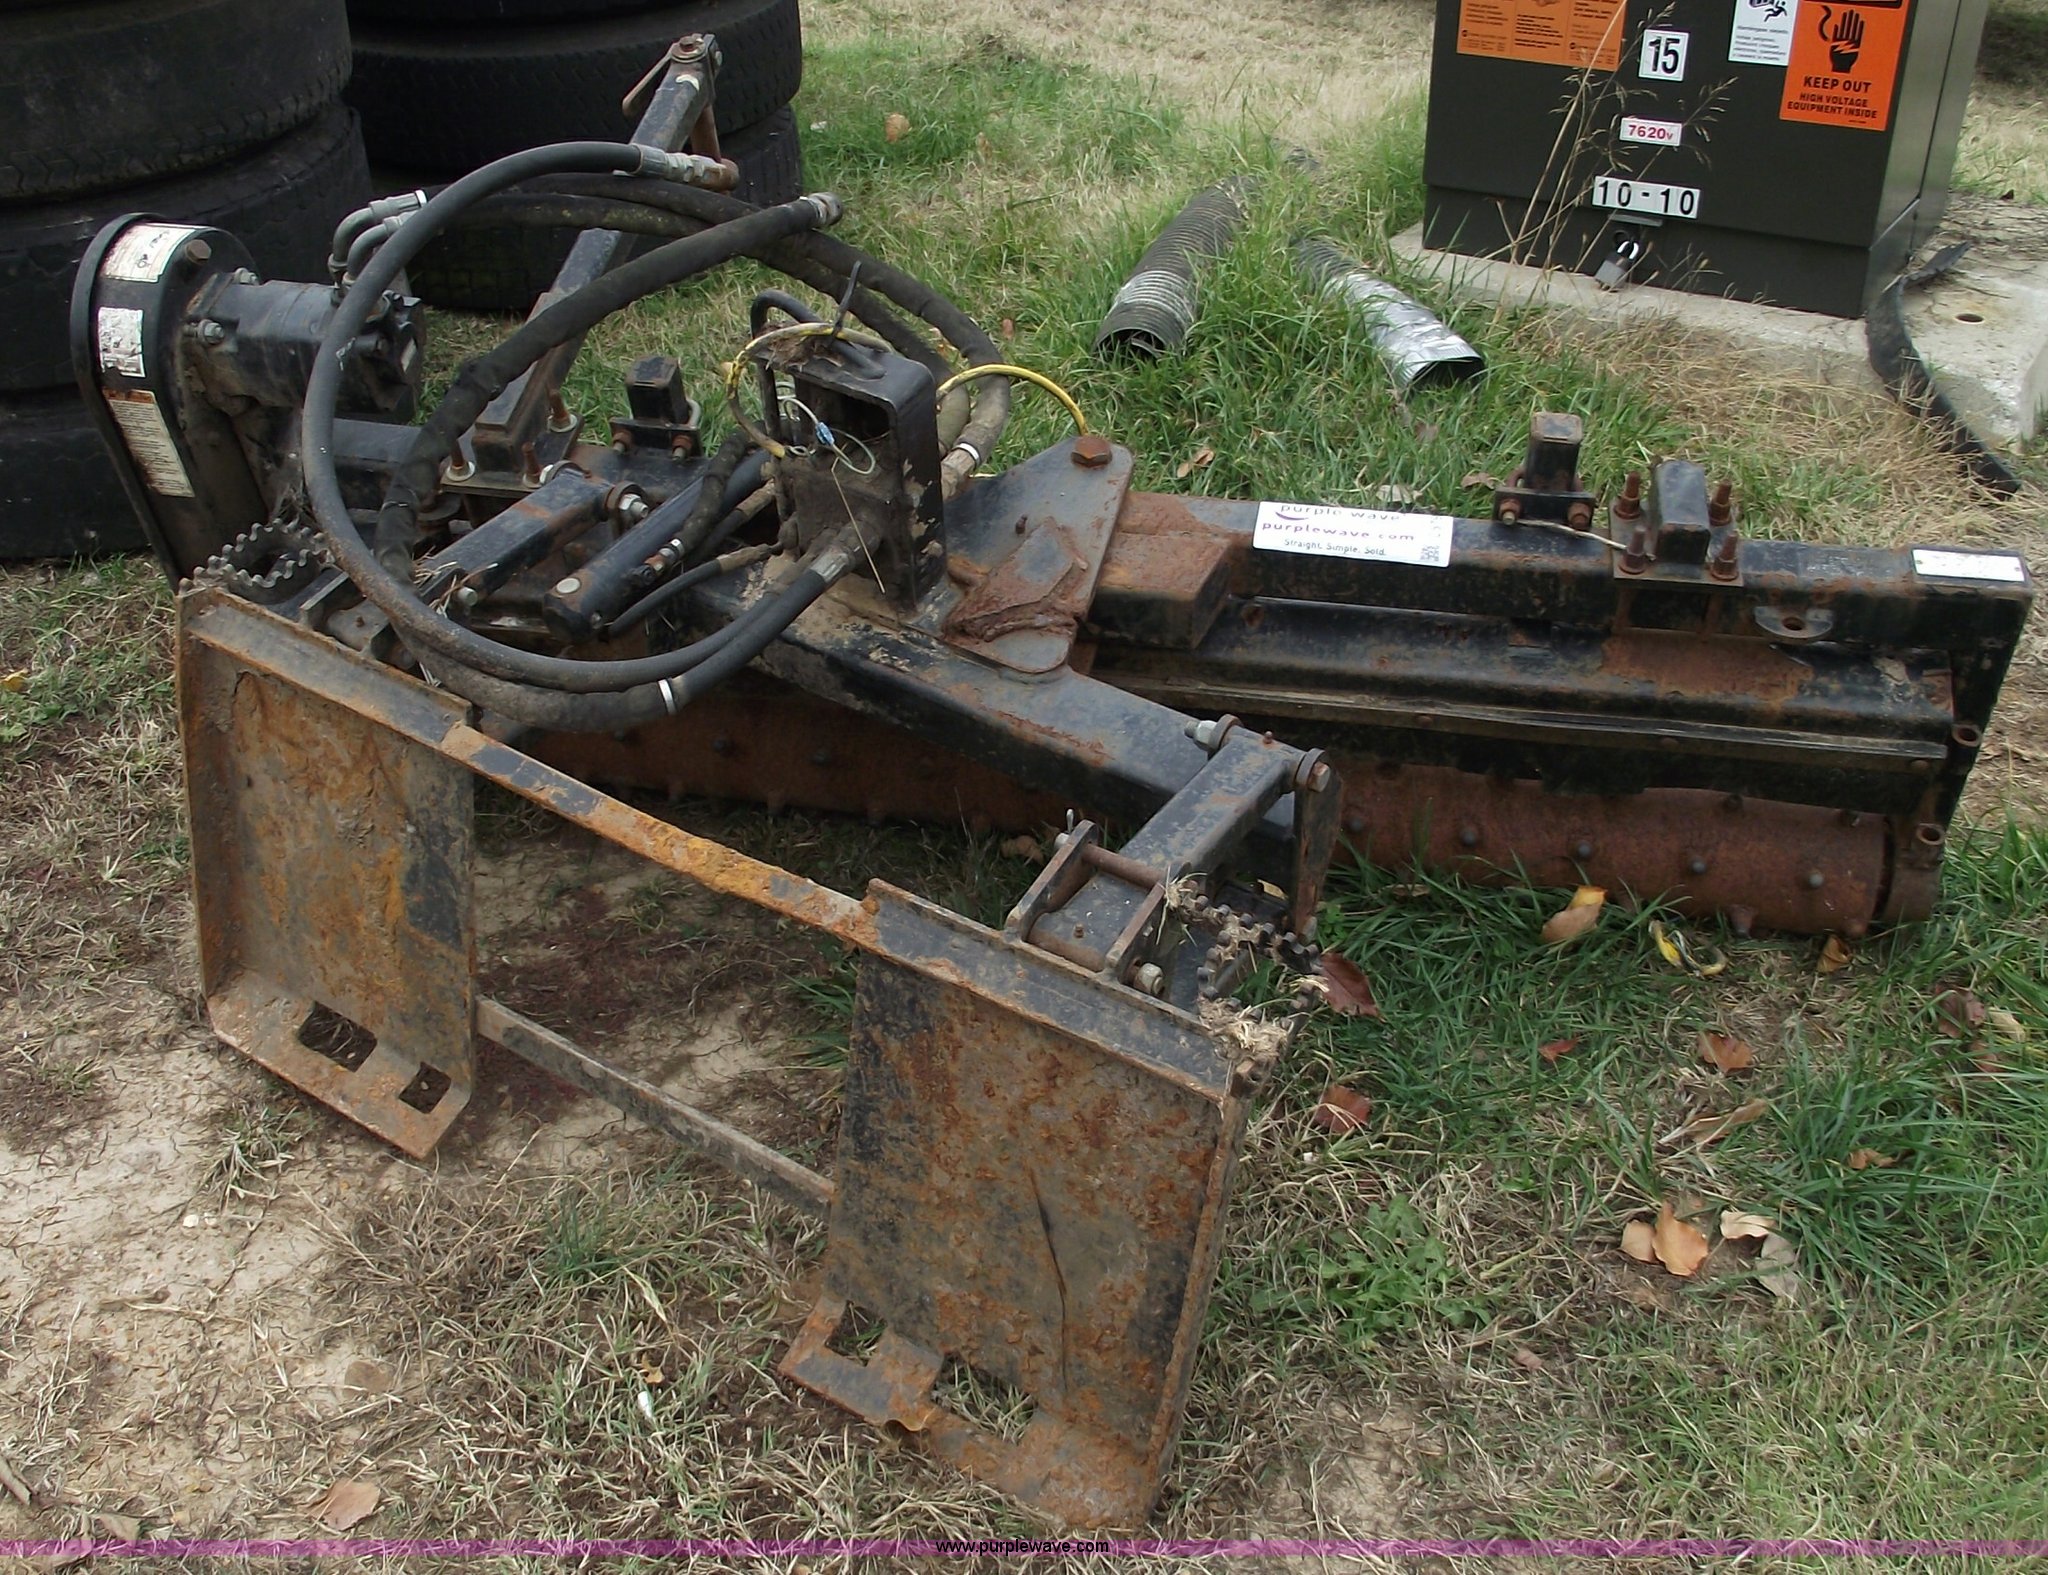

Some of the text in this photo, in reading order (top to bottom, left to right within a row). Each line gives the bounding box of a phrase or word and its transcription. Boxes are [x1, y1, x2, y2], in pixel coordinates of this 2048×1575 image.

[1648, 37, 1680, 74] 15
[1803, 75, 1872, 93] KEEP OUT
[1799, 92, 1869, 108] HIGH VOLTAGE
[1787, 101, 1878, 119] EQUIPMENT INSIDE
[1280, 504, 1400, 521] purple wave
[1262, 522, 1415, 541] purplewavecom
